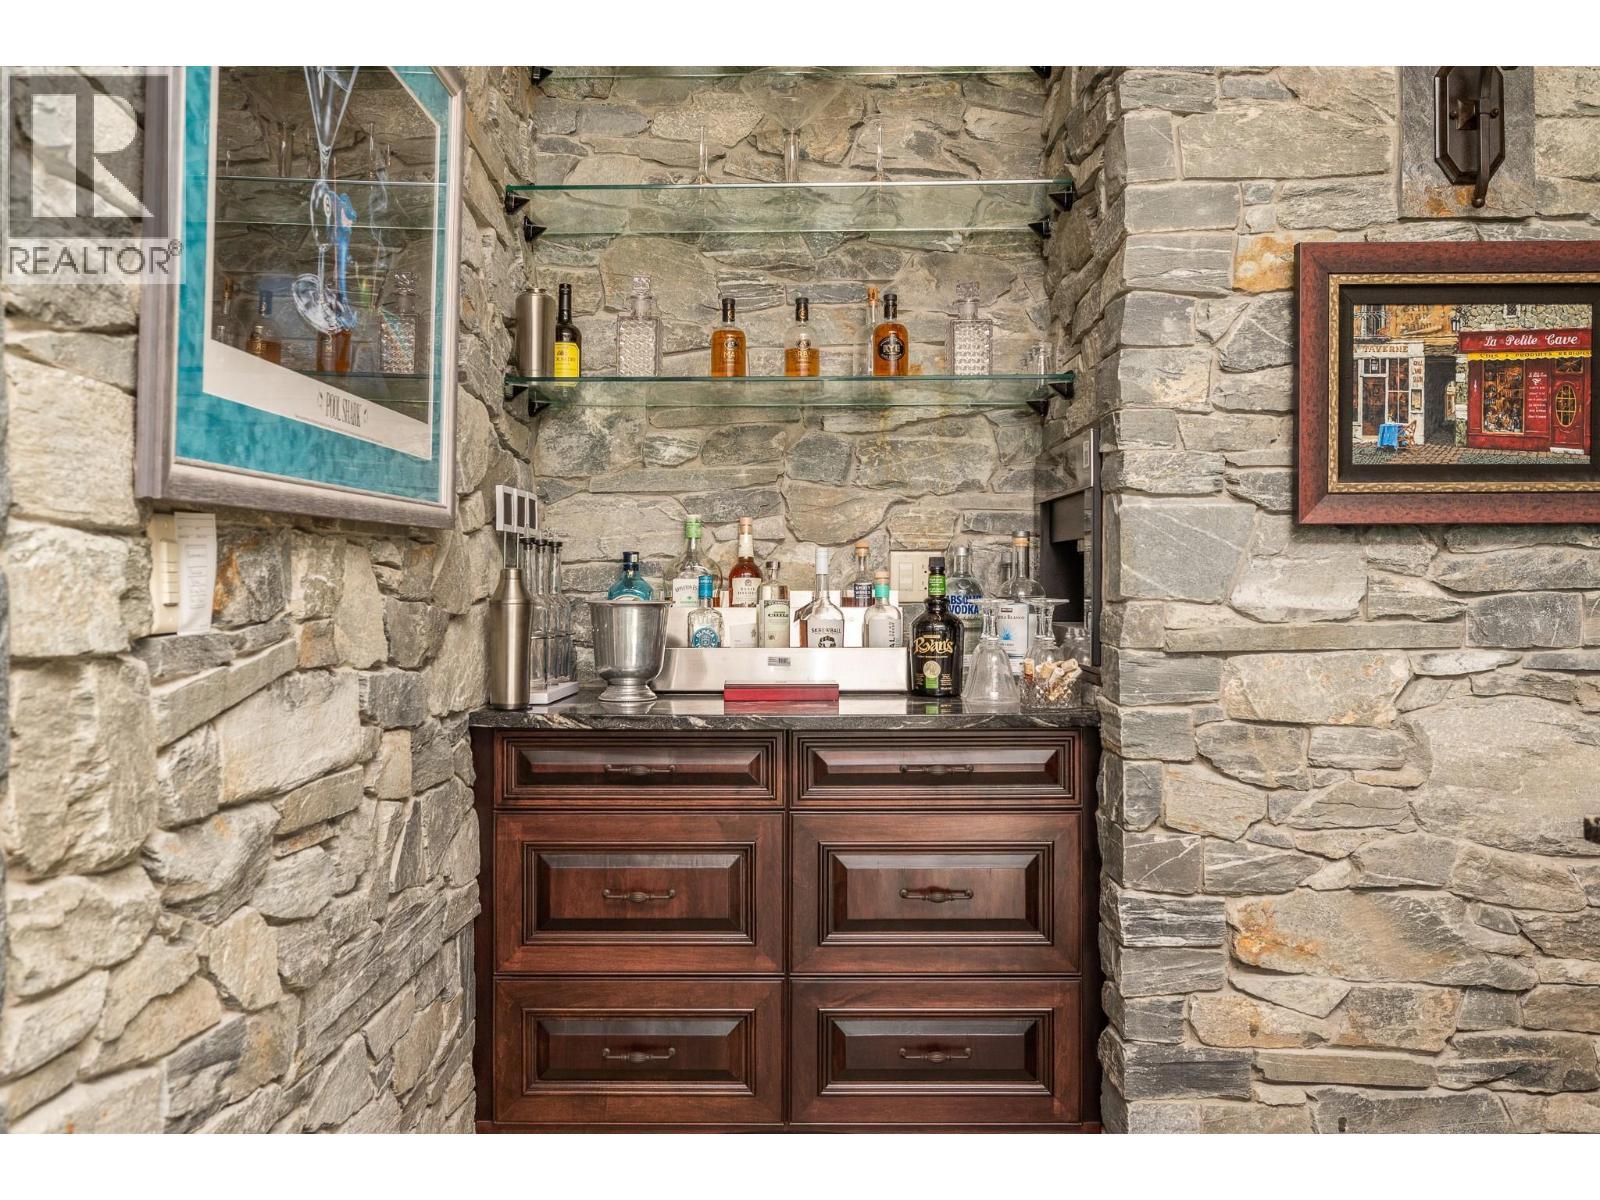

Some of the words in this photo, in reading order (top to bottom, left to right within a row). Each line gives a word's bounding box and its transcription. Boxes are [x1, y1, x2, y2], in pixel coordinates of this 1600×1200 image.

[1484, 335, 1497, 347] La
[1505, 334, 1538, 346] Petite
[1545, 333, 1578, 346] Cave
[1363, 344, 1409, 353] TAVERNE
[946, 595, 983, 605] ABSO
[949, 605, 979, 615] VODKA
